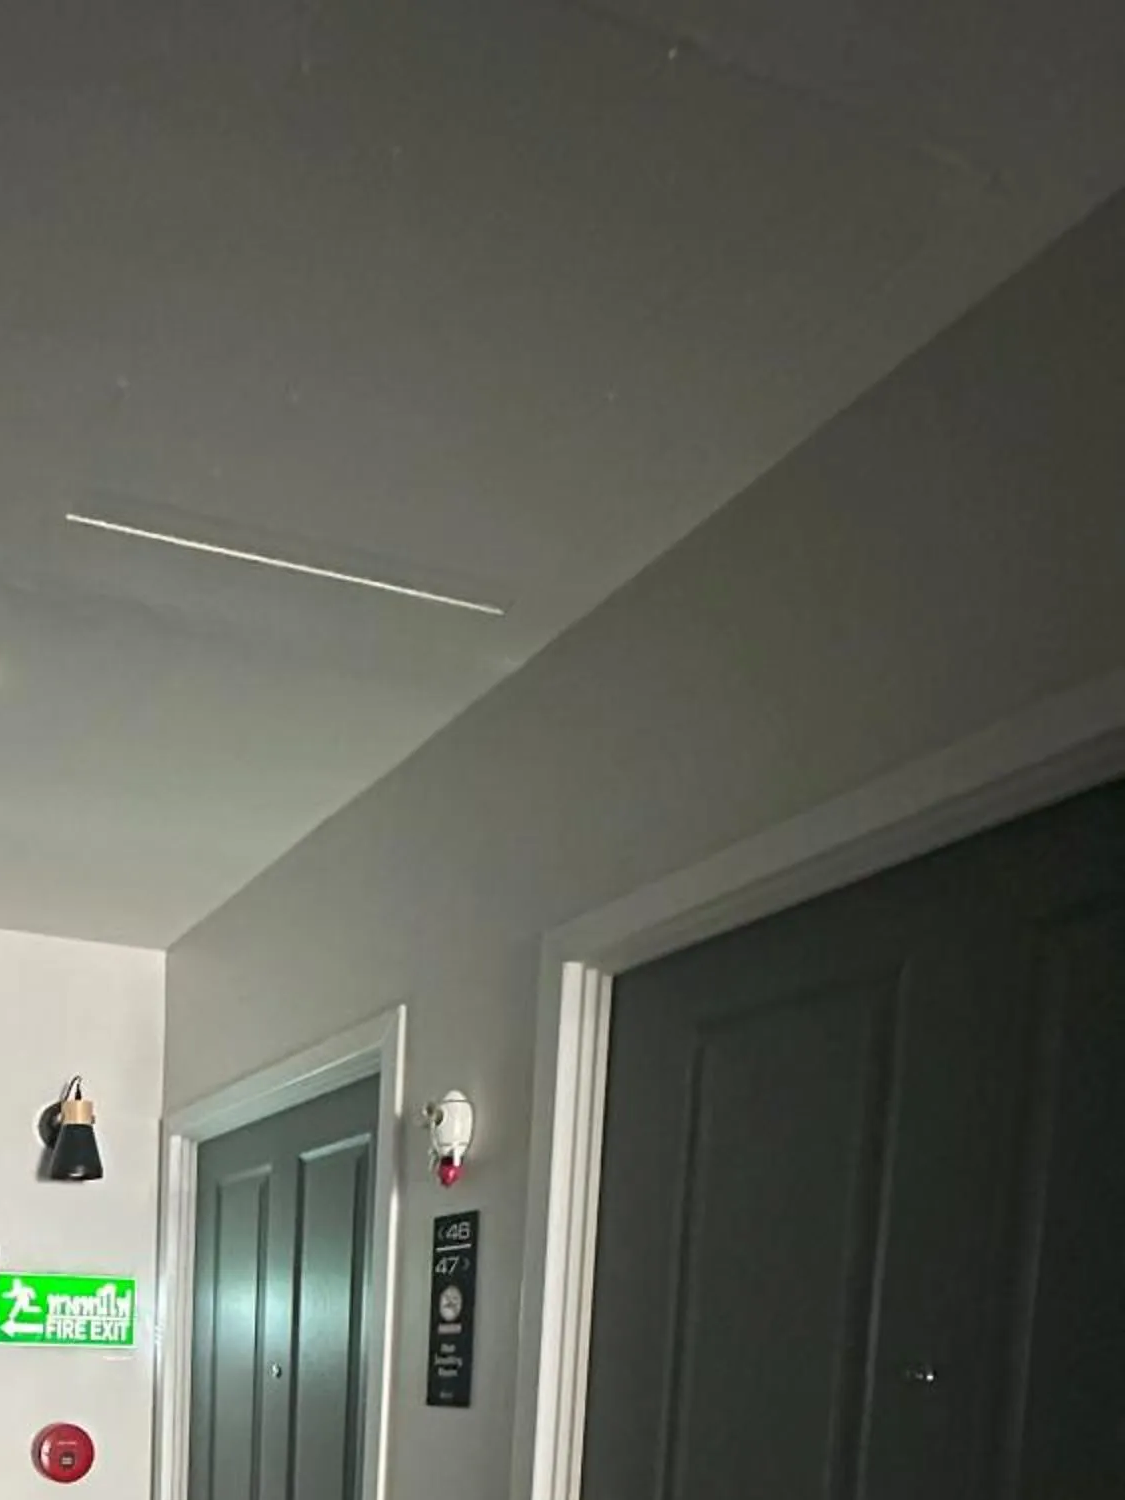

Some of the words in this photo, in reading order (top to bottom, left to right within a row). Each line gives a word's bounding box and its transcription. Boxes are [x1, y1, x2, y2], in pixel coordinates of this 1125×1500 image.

[434, 1255, 460, 1275] 47
[46, 1319, 88, 1340] FIRE
[91, 1320, 128, 1342] EXIT
